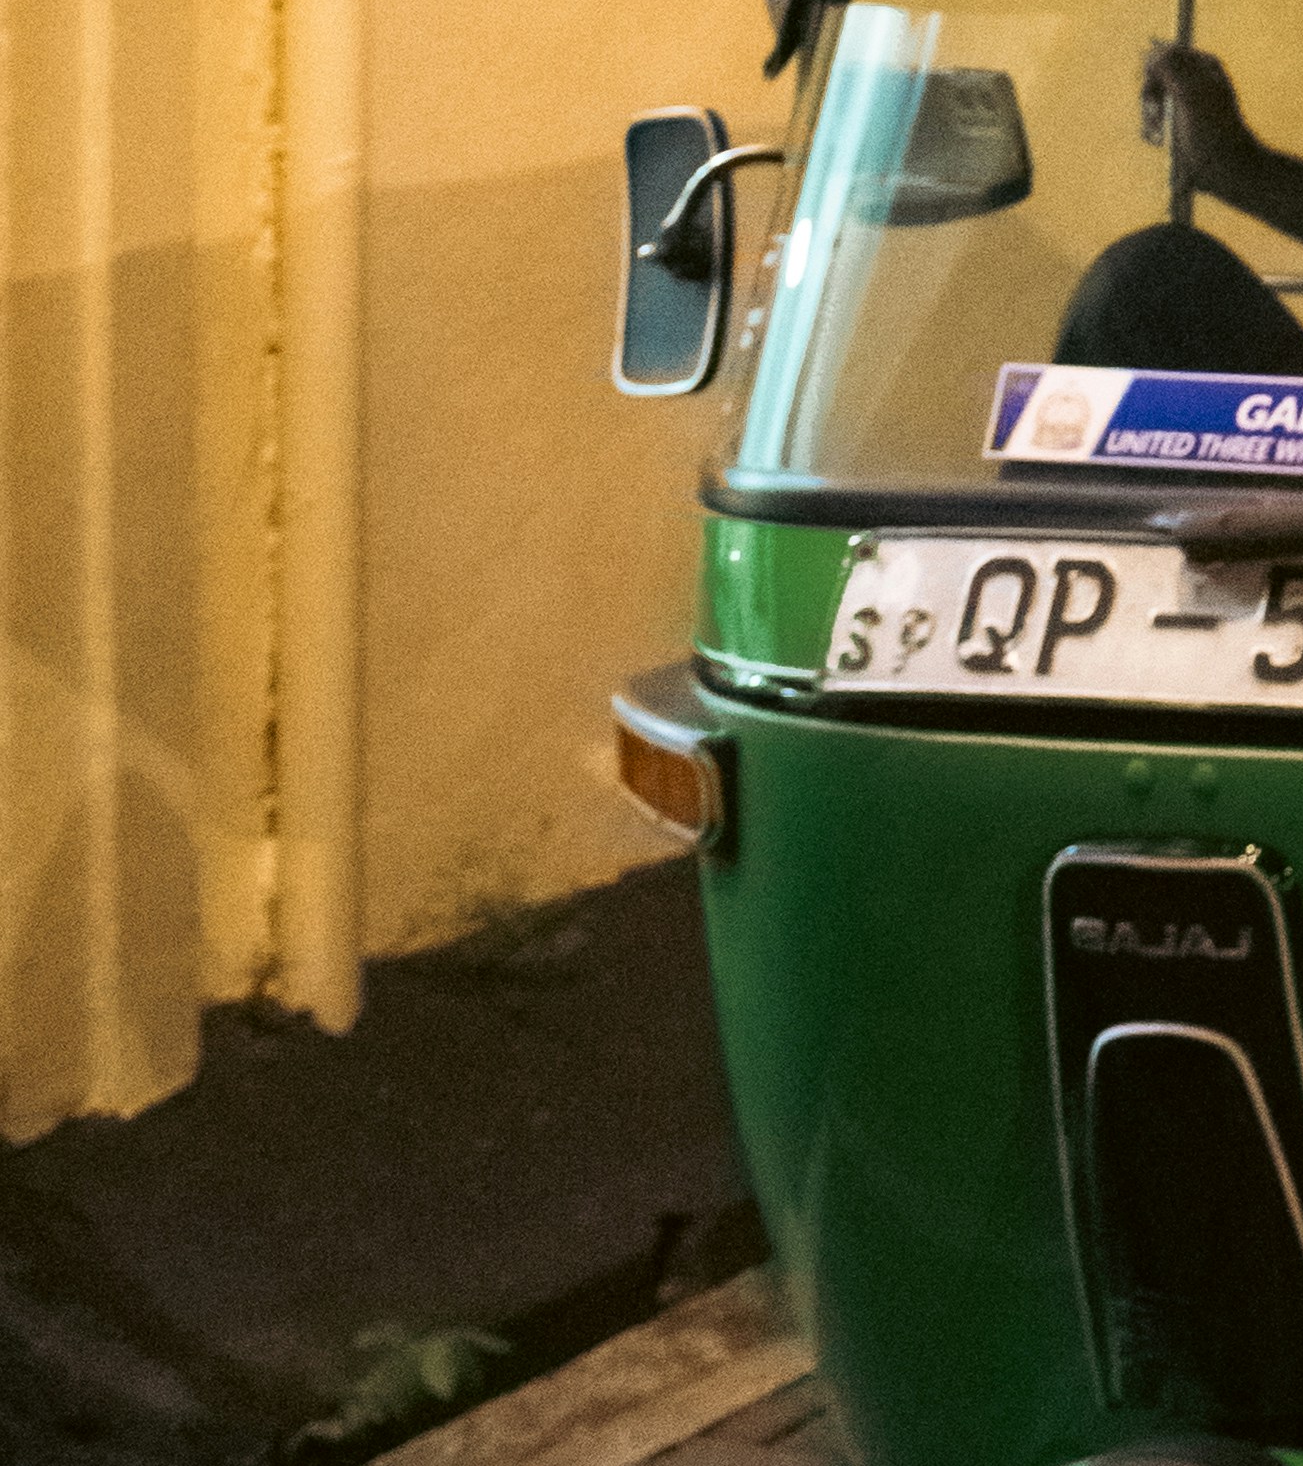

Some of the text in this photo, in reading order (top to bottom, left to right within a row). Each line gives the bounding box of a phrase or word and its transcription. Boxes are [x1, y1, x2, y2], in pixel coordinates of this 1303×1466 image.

[1105, 429, 1196, 458] UNITED
[1198, 432, 1274, 463] THREE
[956, 555, 1115, 677] QP
[1070, 916, 1253, 960] BAJAJ
